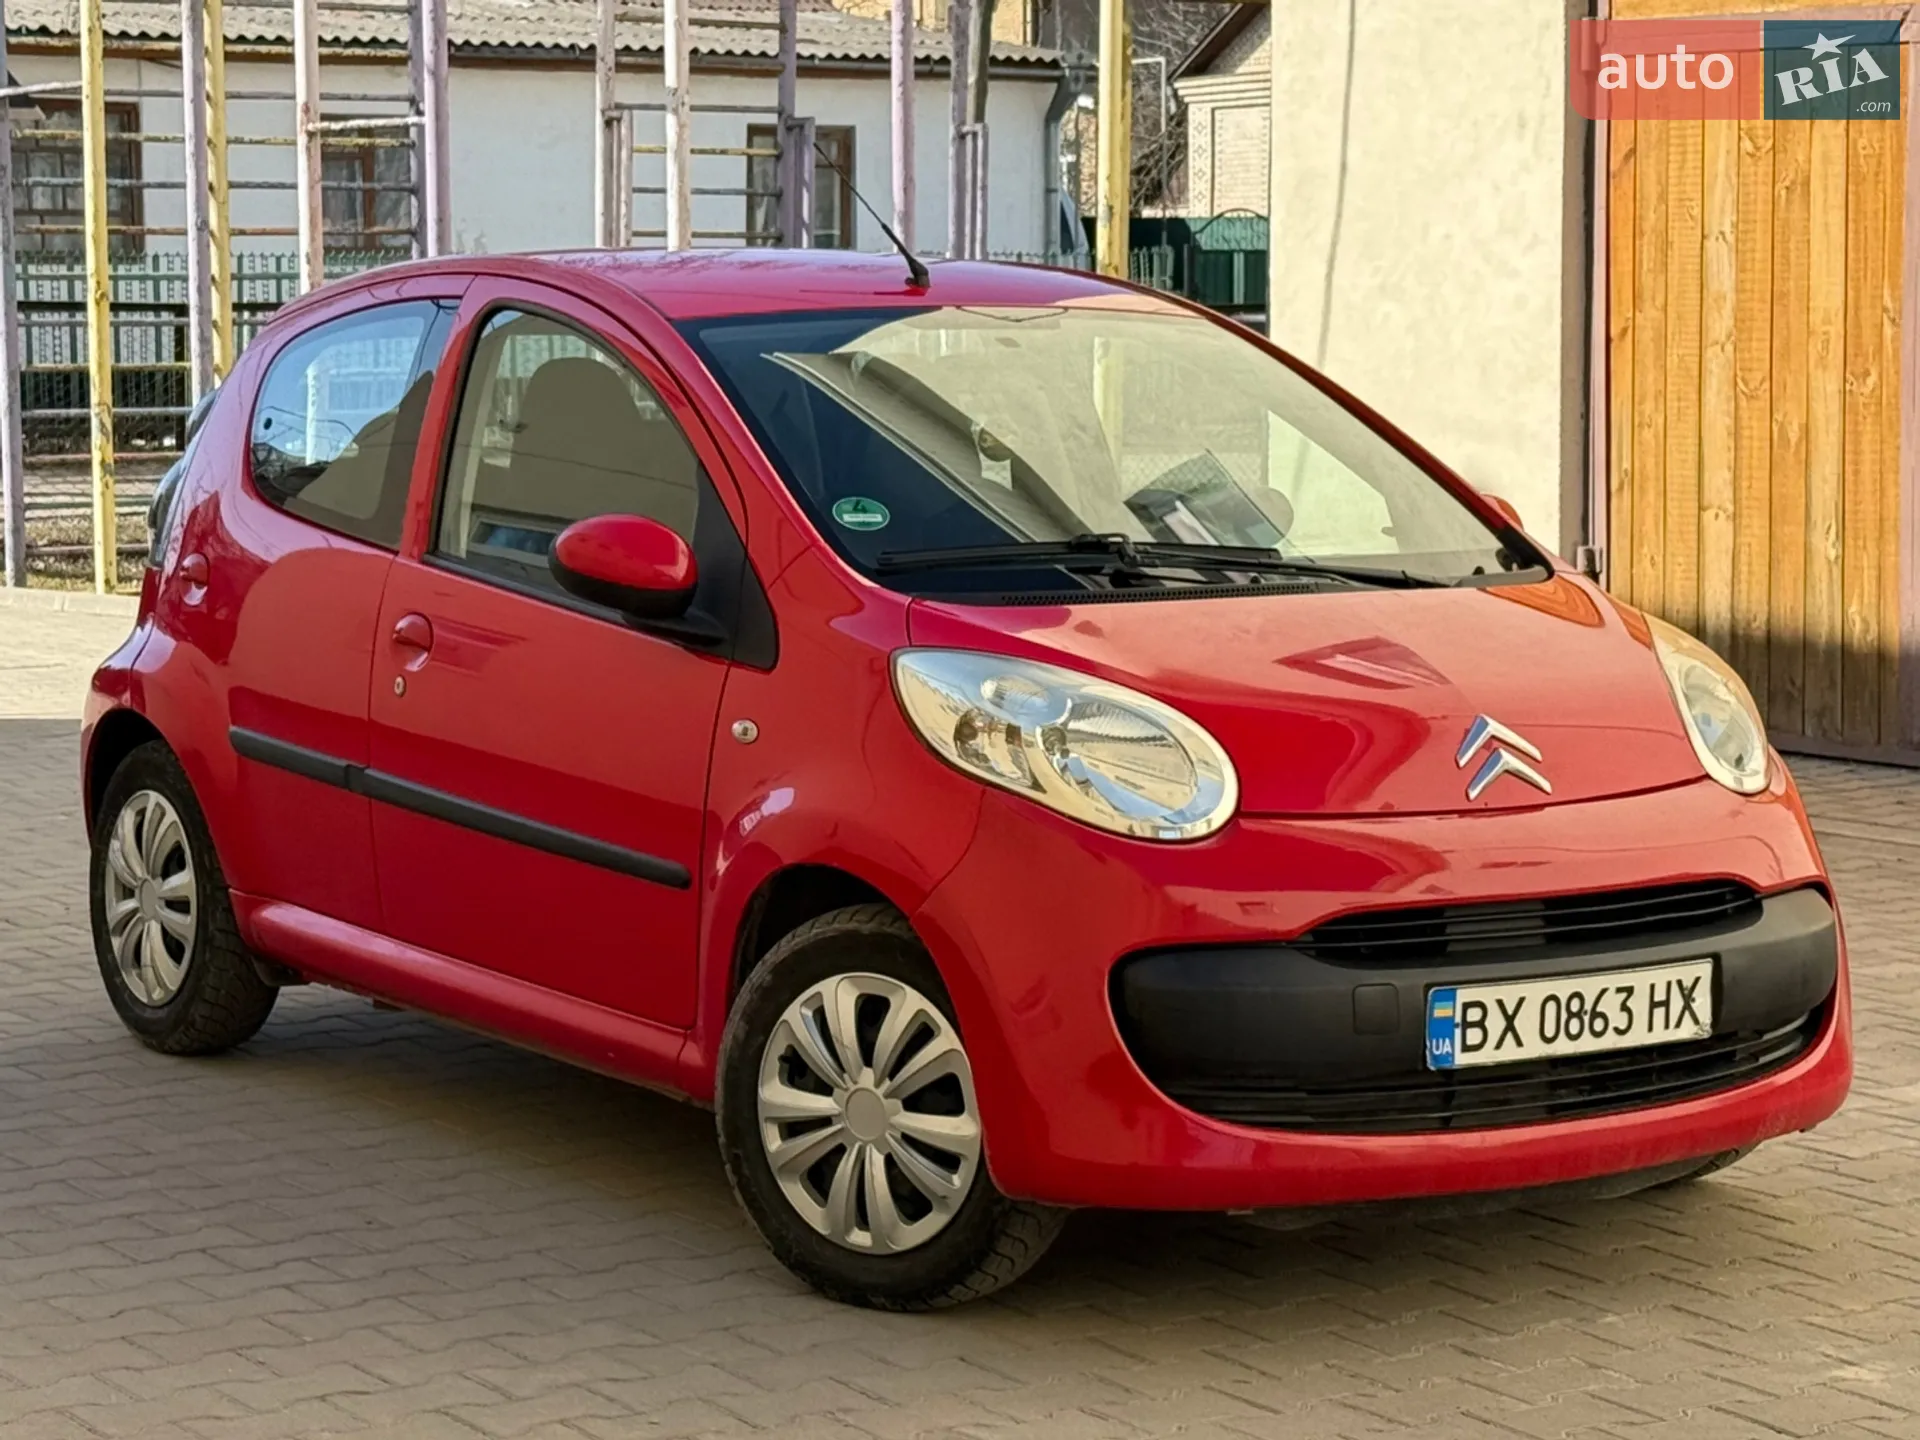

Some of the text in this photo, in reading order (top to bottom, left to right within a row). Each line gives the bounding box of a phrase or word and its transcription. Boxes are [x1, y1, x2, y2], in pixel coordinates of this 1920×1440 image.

[1460, 976, 1702, 1053] BX 0863 HX
[1432, 1038, 1452, 1055] UA
